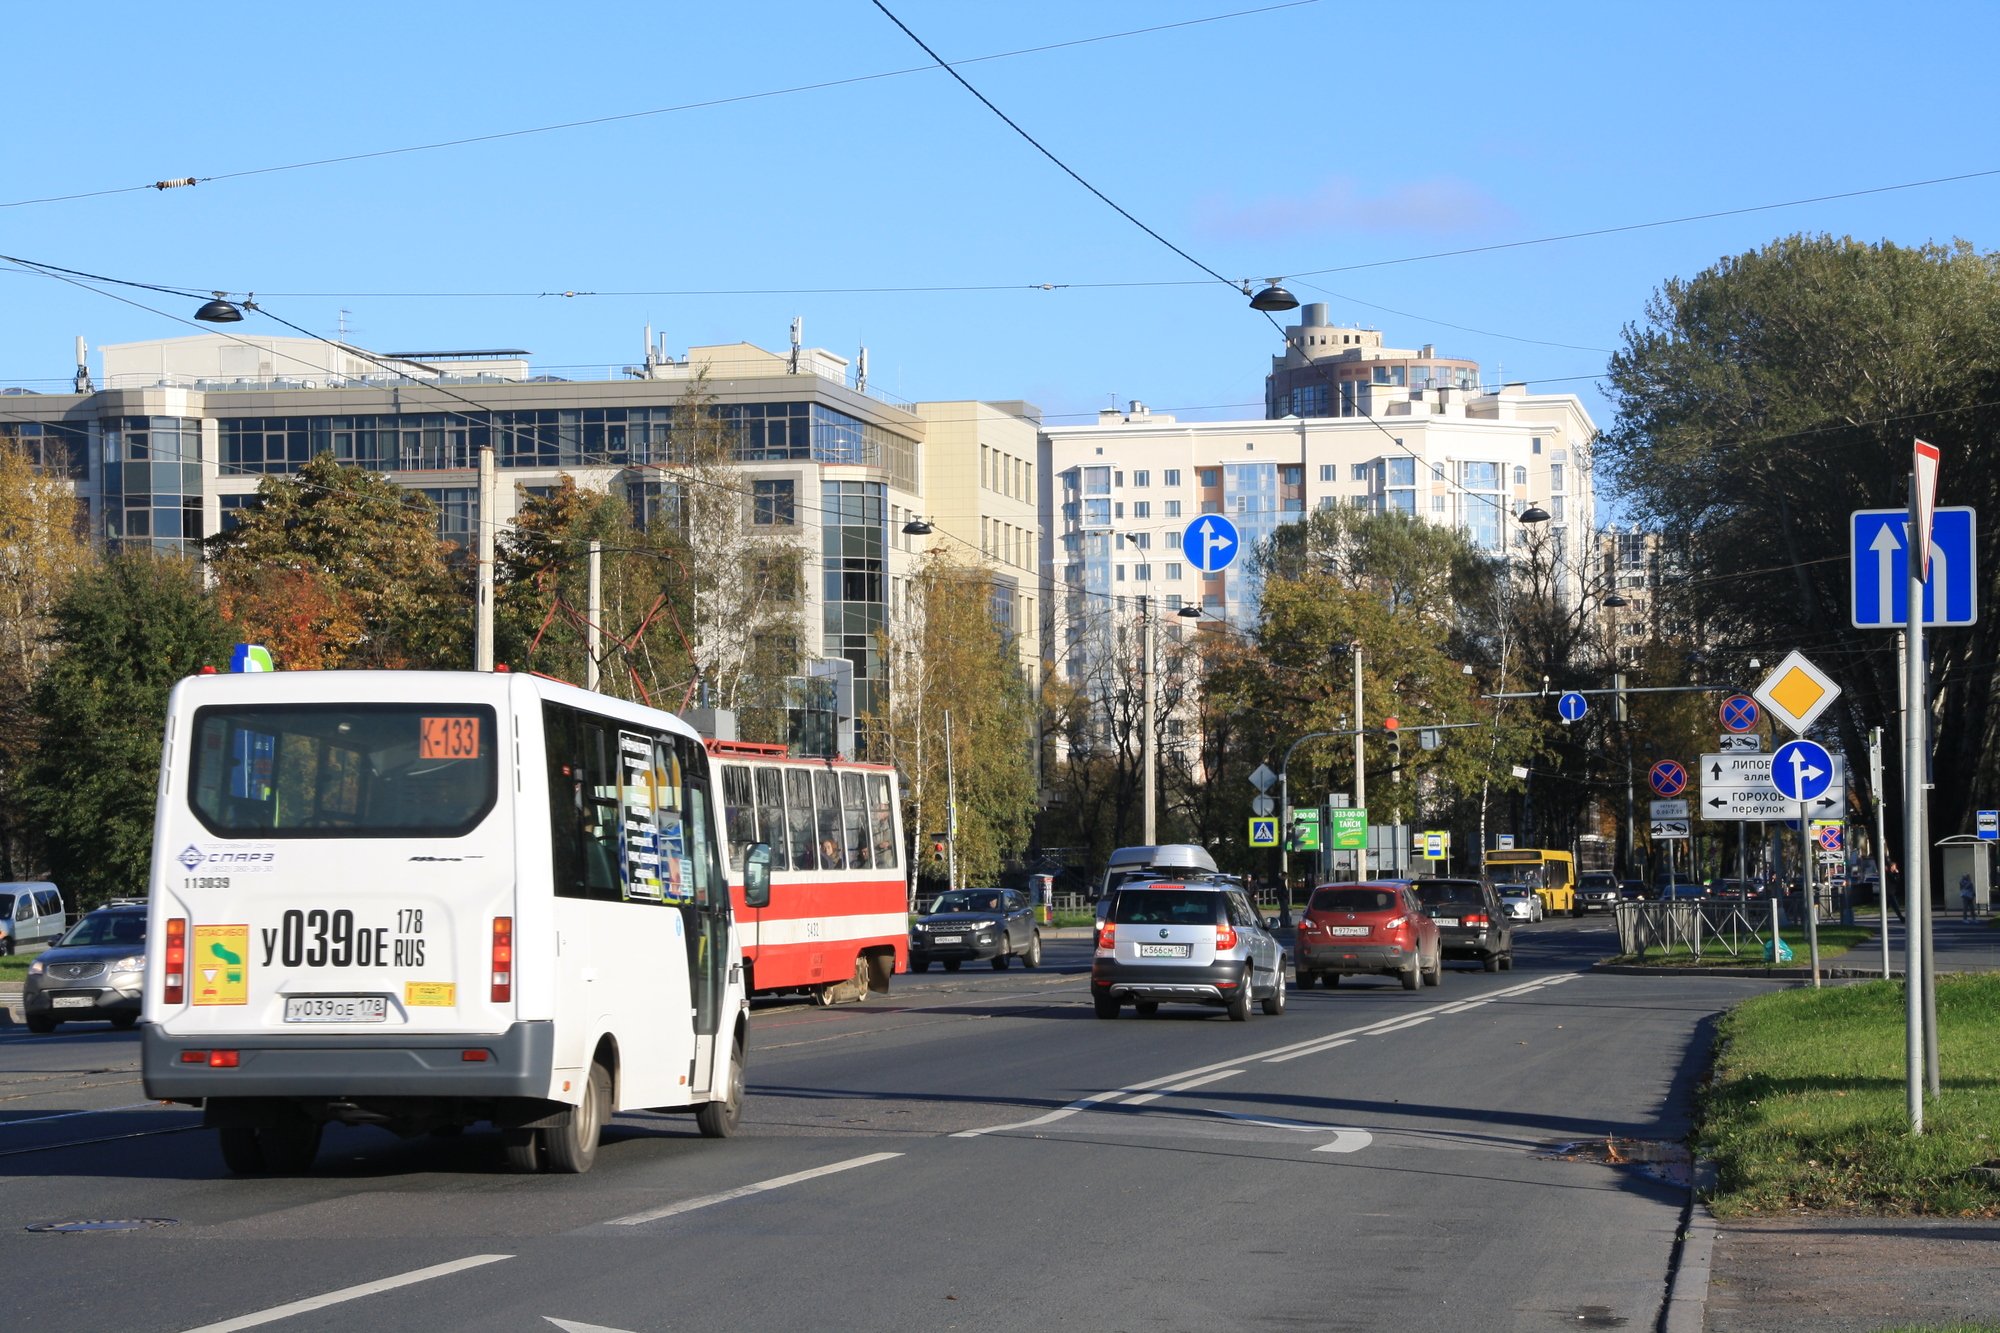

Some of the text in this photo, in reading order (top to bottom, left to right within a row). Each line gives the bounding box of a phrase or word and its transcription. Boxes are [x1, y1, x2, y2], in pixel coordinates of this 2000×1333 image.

[421, 719, 474, 756] К-133
[1731, 760, 1770, 770] ЛИПОВ
[1732, 792, 1785, 802] ГОРОХОВ
[1732, 805, 1785, 815] переулок
[1339, 820, 1361, 828] ТАКСИ
[208, 853, 275, 863] СПАРЗ
[397, 908, 423, 934] 178
[394, 938, 425, 967] RUS
[294, 999, 384, 1017] У039ОЕ 178
